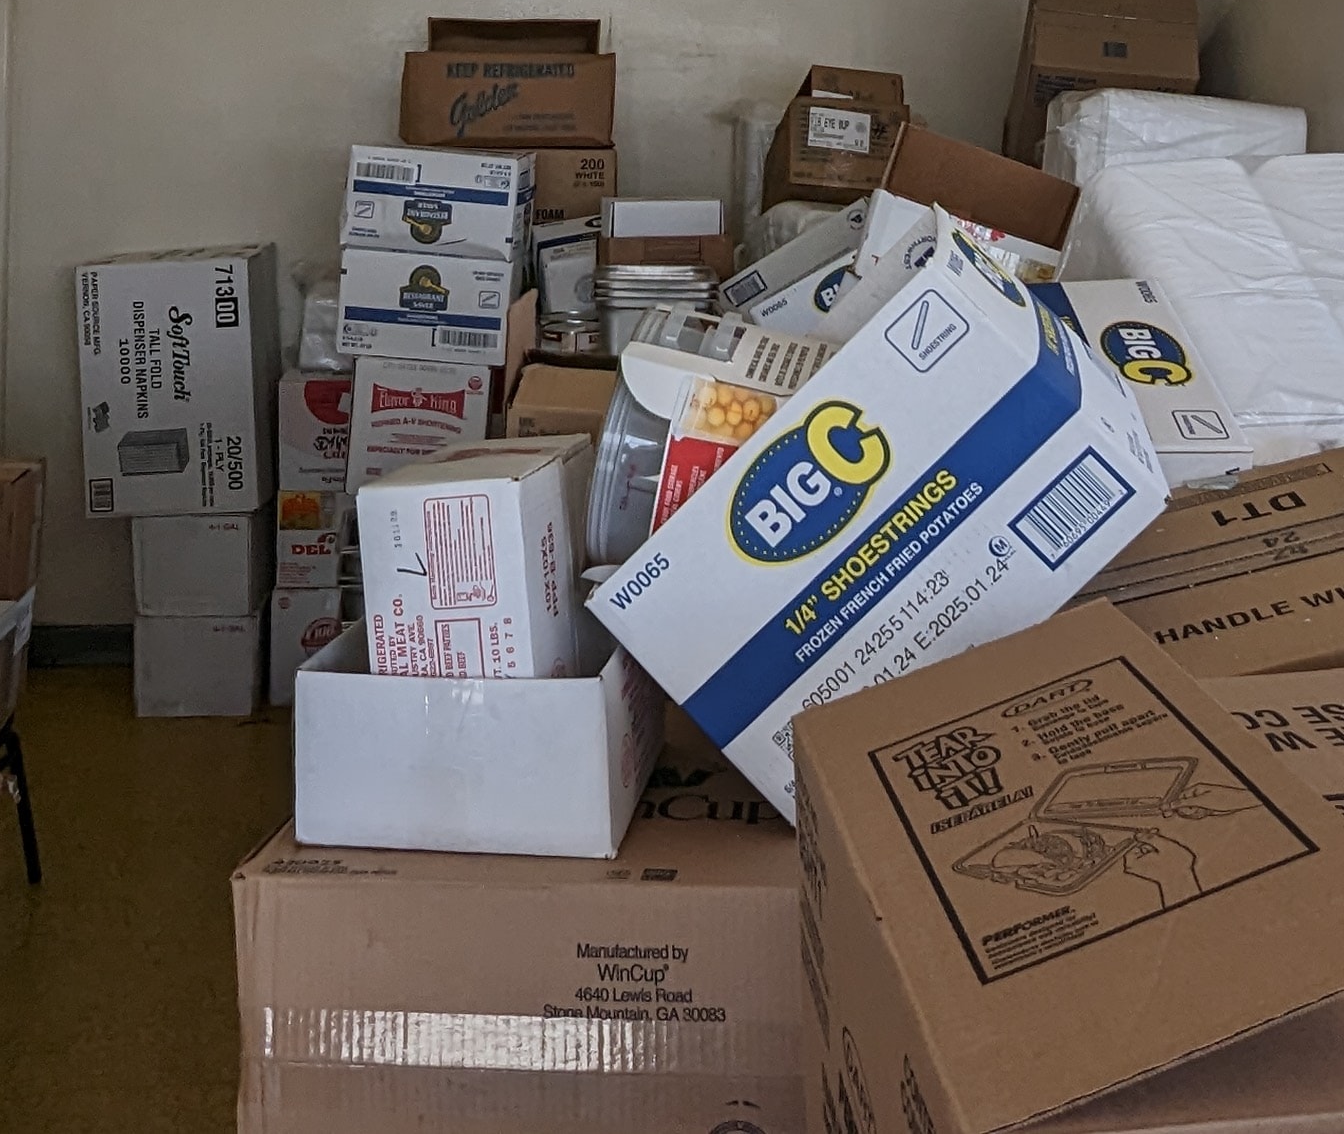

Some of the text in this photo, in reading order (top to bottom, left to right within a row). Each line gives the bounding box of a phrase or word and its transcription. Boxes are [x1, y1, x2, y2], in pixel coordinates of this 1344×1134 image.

[580, 158, 604, 170] 200
[536, 208, 564, 220] FOAM
[212, 263, 239, 328] 71300
[130, 300, 149, 419] DISPENSER NAPKINS
[147, 328, 162, 389] TALL FOLD
[916, 321, 959, 362] SHOESTRING
[1118, 325, 1149, 360] BIG
[117, 338, 131, 385] 10000
[375, 386, 457, 414] Flavor King
[225, 435, 243, 491] 20/500
[744, 461, 834, 550] BIG
[805, 399, 886, 485] C
[1209, 489, 1306, 528] DT1
[291, 544, 331, 555] DEL
[816, 466, 961, 603] SHOESTRINGS
[606, 549, 673, 614] W0065
[792, 479, 986, 664] FROZEN FRENCH FRIED POTATOES
[391, 593, 404, 616] CO.
[1155, 599, 1296, 646] HANDLE
[373, 613, 388, 675] RIGERATED
[394, 619, 407, 657] MEAT
[441, 622, 453, 669] BEEF PATTIES
[488, 621, 499, 646] LBS.
[504, 631, 513, 639] 7
[409, 646, 419, 676] USTRY
[418, 647, 427, 661] CA
[491, 648, 500, 663] 10
[1026, 709, 1059, 727] Grab
[1058, 701, 1081, 714] the
[1081, 693, 1101, 706] lid
[1036, 723, 1069, 741] Hold
[1068, 714, 1092, 728] the
[1091, 702, 1125, 719] base
[890, 717, 999, 774] TEAR
[1046, 733, 1092, 756] Gently
[1092, 721, 1119, 738] pull
[1119, 708, 1156, 728] apart
[577, 942, 690, 964] Manufactured by
[574, 986, 693, 1004] 4640 Lewis Road
[656, 1004, 681, 1022] GA
